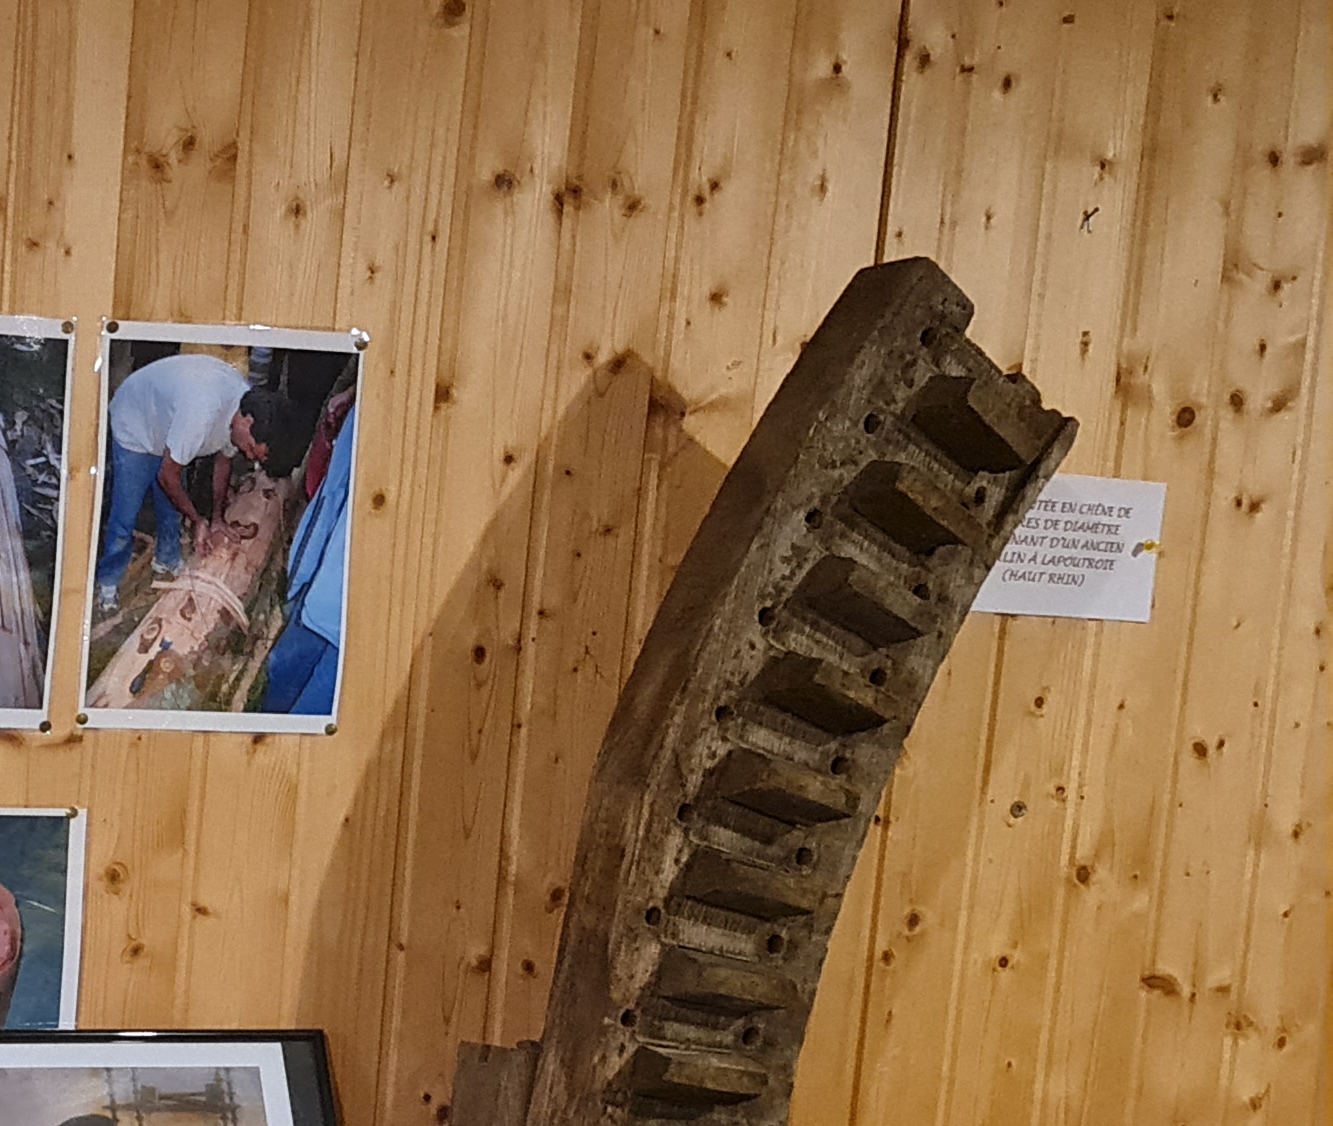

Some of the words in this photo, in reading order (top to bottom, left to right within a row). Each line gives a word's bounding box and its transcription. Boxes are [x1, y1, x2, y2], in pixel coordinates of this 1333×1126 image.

[1031, 499, 1059, 513] TÉE
[1060, 501, 1078, 514] EN
[1117, 506, 1133, 519] DE
[1022, 517, 1042, 530] ES
[1043, 518, 1061, 532] DE
[1050, 536, 1080, 550] D'UN
[1081, 540, 1126, 554] ANCIEN
[1041, 554, 1117, 571] LAPOUTROIE
[1002, 569, 1046, 583] (HAUT
[1048, 572, 1086, 588] RHIN)
